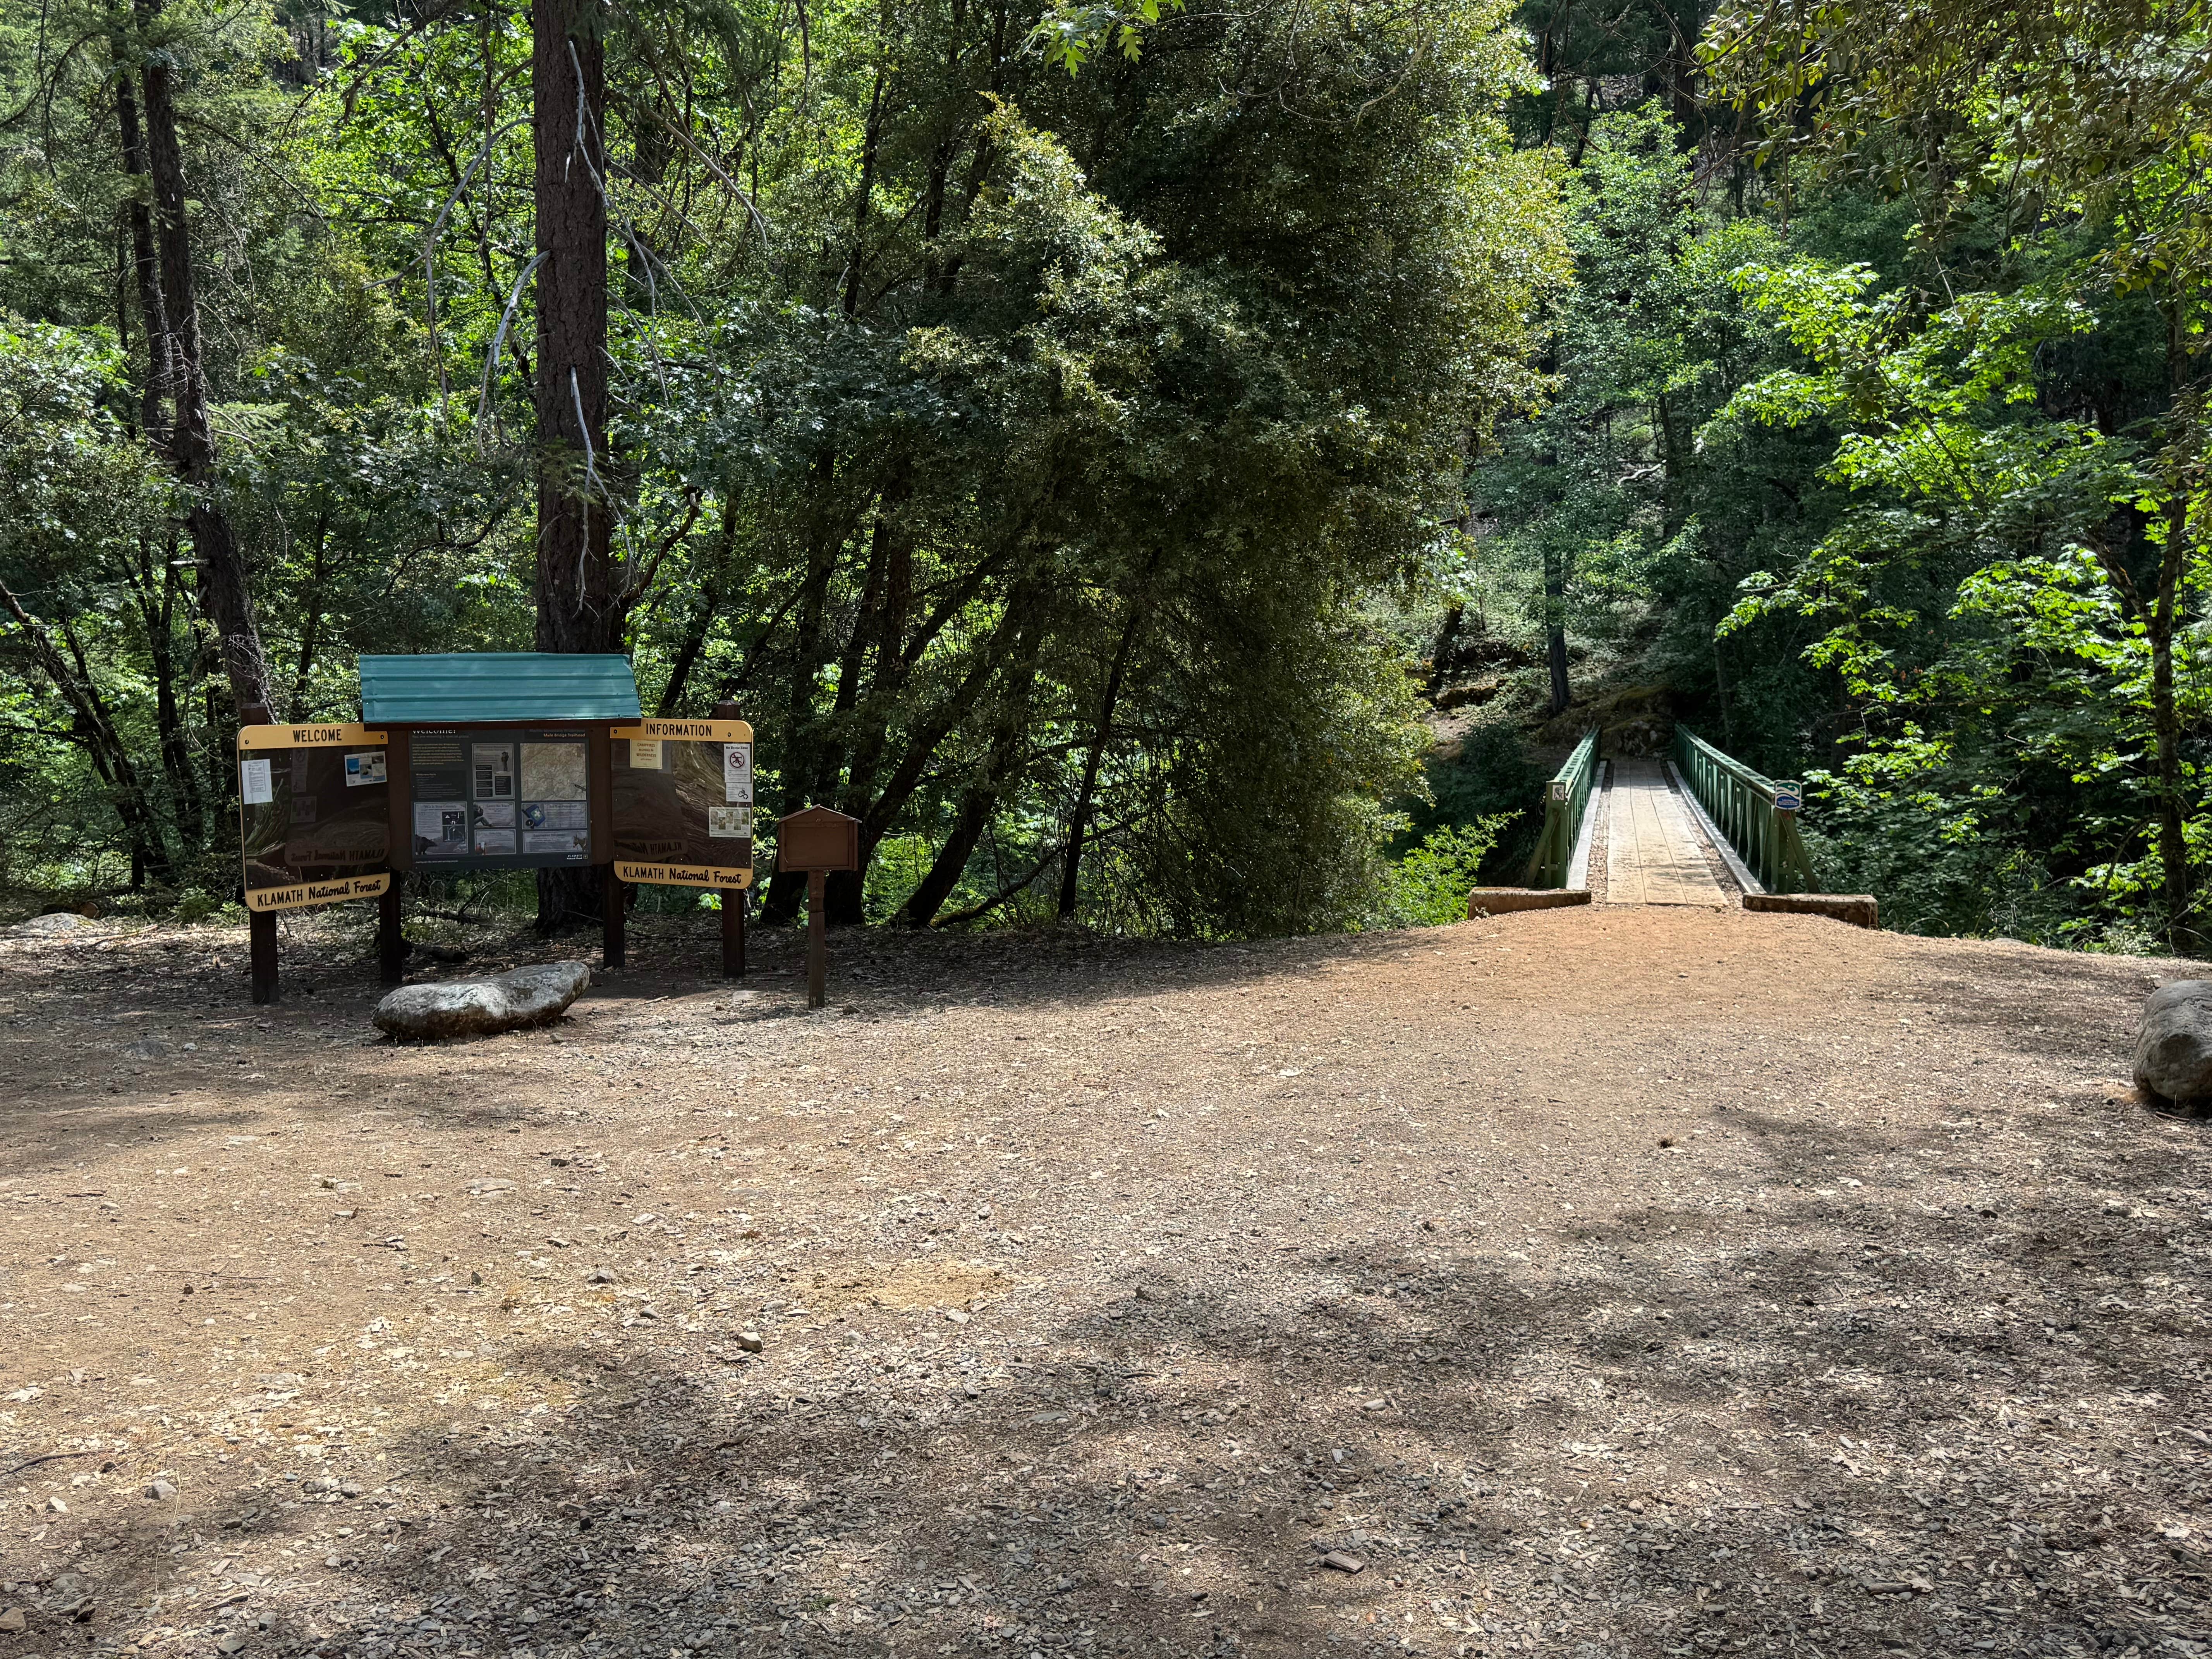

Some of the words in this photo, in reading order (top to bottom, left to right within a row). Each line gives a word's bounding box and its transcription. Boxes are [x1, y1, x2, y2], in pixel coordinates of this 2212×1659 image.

[293, 729, 342, 743] WELCOME
[646, 723, 712, 736] INFORMATION
[623, 866, 664, 879] KLAMATH
[669, 868, 709, 882] National
[713, 871, 742, 884] Forest
[257, 889, 303, 907] KLAMATH
[309, 881, 350, 900] National
[353, 879, 381, 893] Forest
